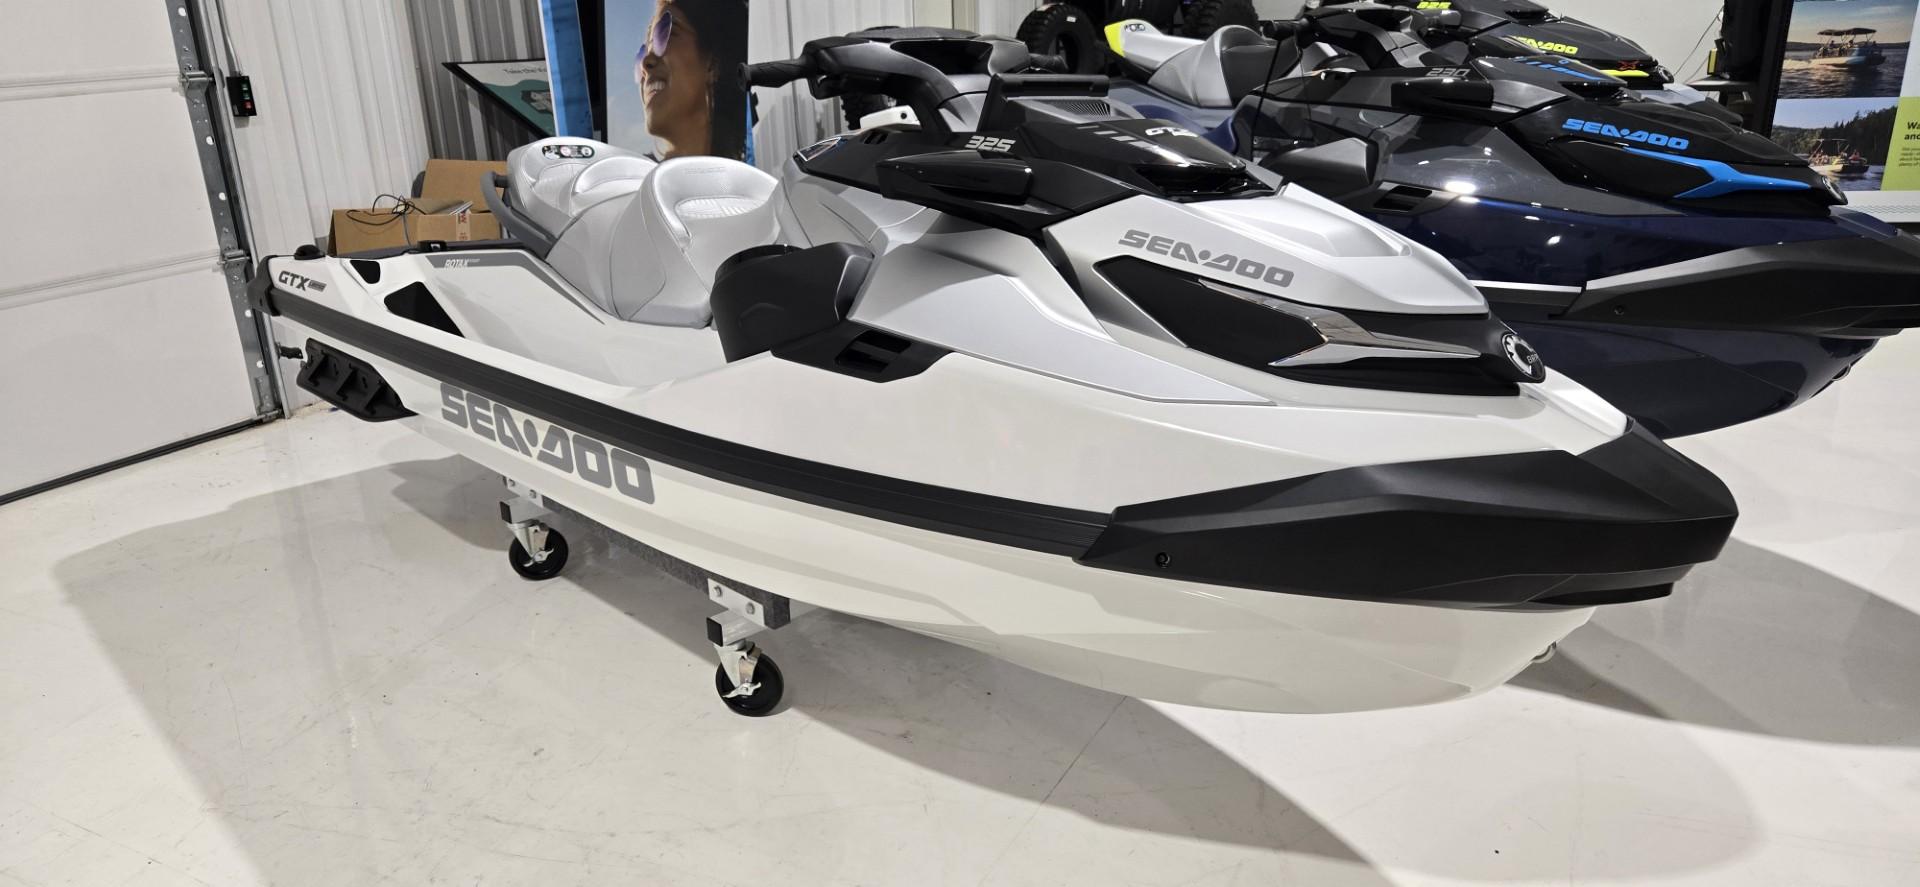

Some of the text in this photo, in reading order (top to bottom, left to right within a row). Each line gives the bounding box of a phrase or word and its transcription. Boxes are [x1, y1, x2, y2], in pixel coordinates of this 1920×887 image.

[1426, 67, 1471, 77] 230
[964, 135, 1016, 152] 325
[279, 270, 310, 291] GTX
